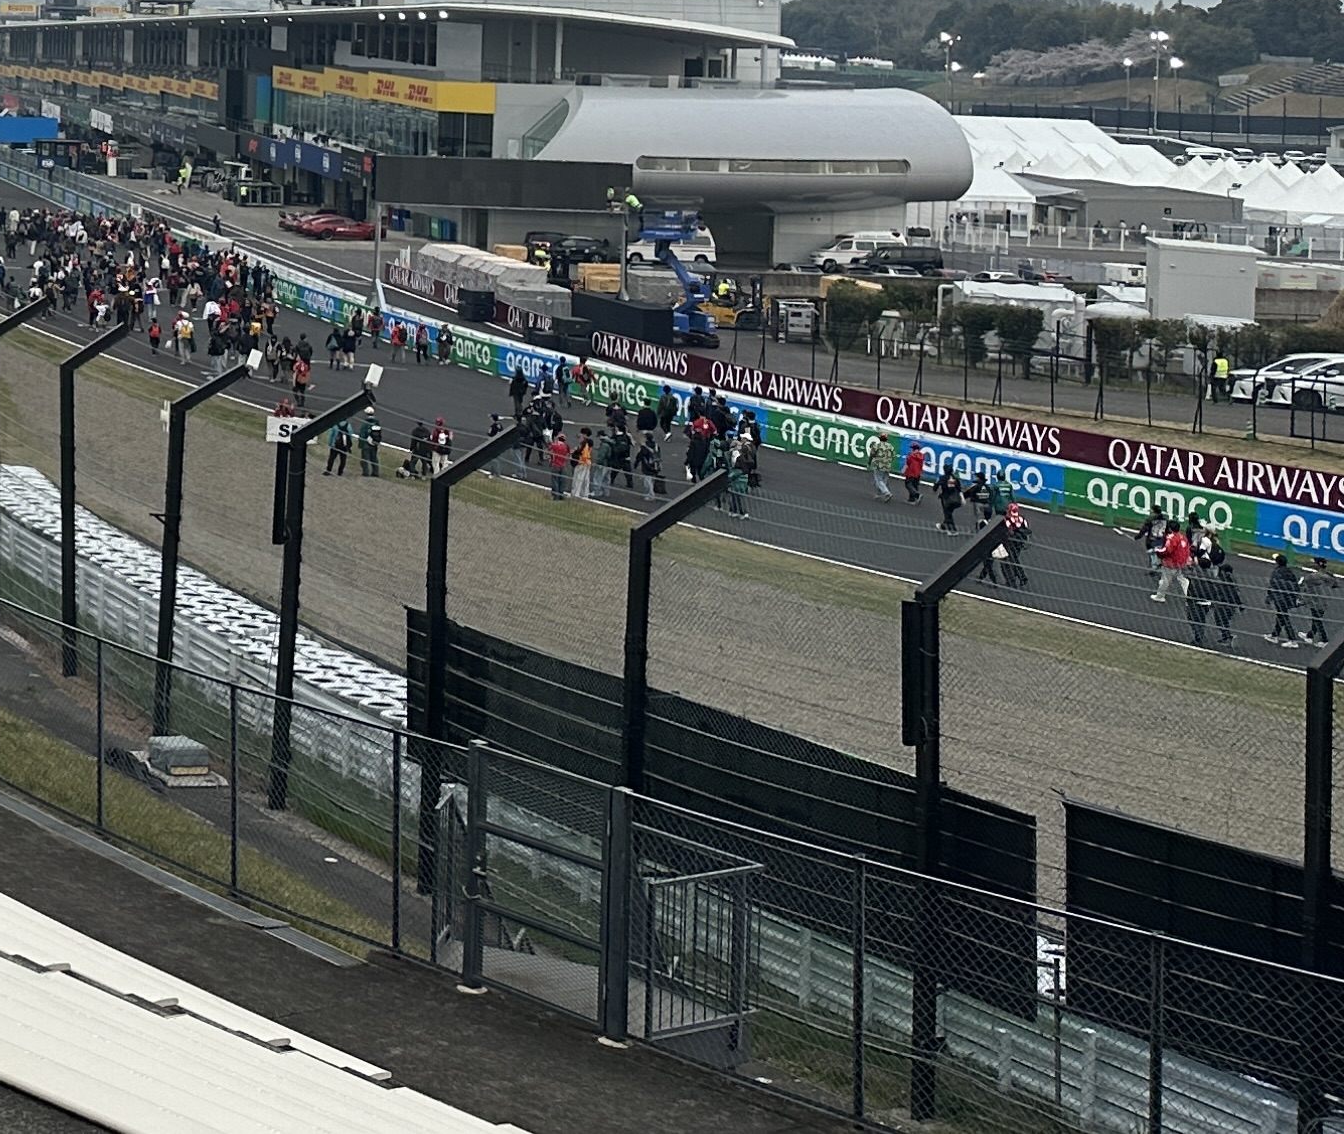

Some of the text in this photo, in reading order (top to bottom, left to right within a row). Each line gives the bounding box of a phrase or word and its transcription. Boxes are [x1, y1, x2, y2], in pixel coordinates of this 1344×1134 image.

[591, 331, 688, 377] QATAR AIRWAYS
[711, 360, 763, 395] QATAR
[766, 373, 843, 413] AIRWAYS
[876, 396, 1061, 456] QATAR AIRWAYS
[920, 446, 1043, 494] aramco
[1108, 438, 1344, 509] QATAR AIRWAYS
